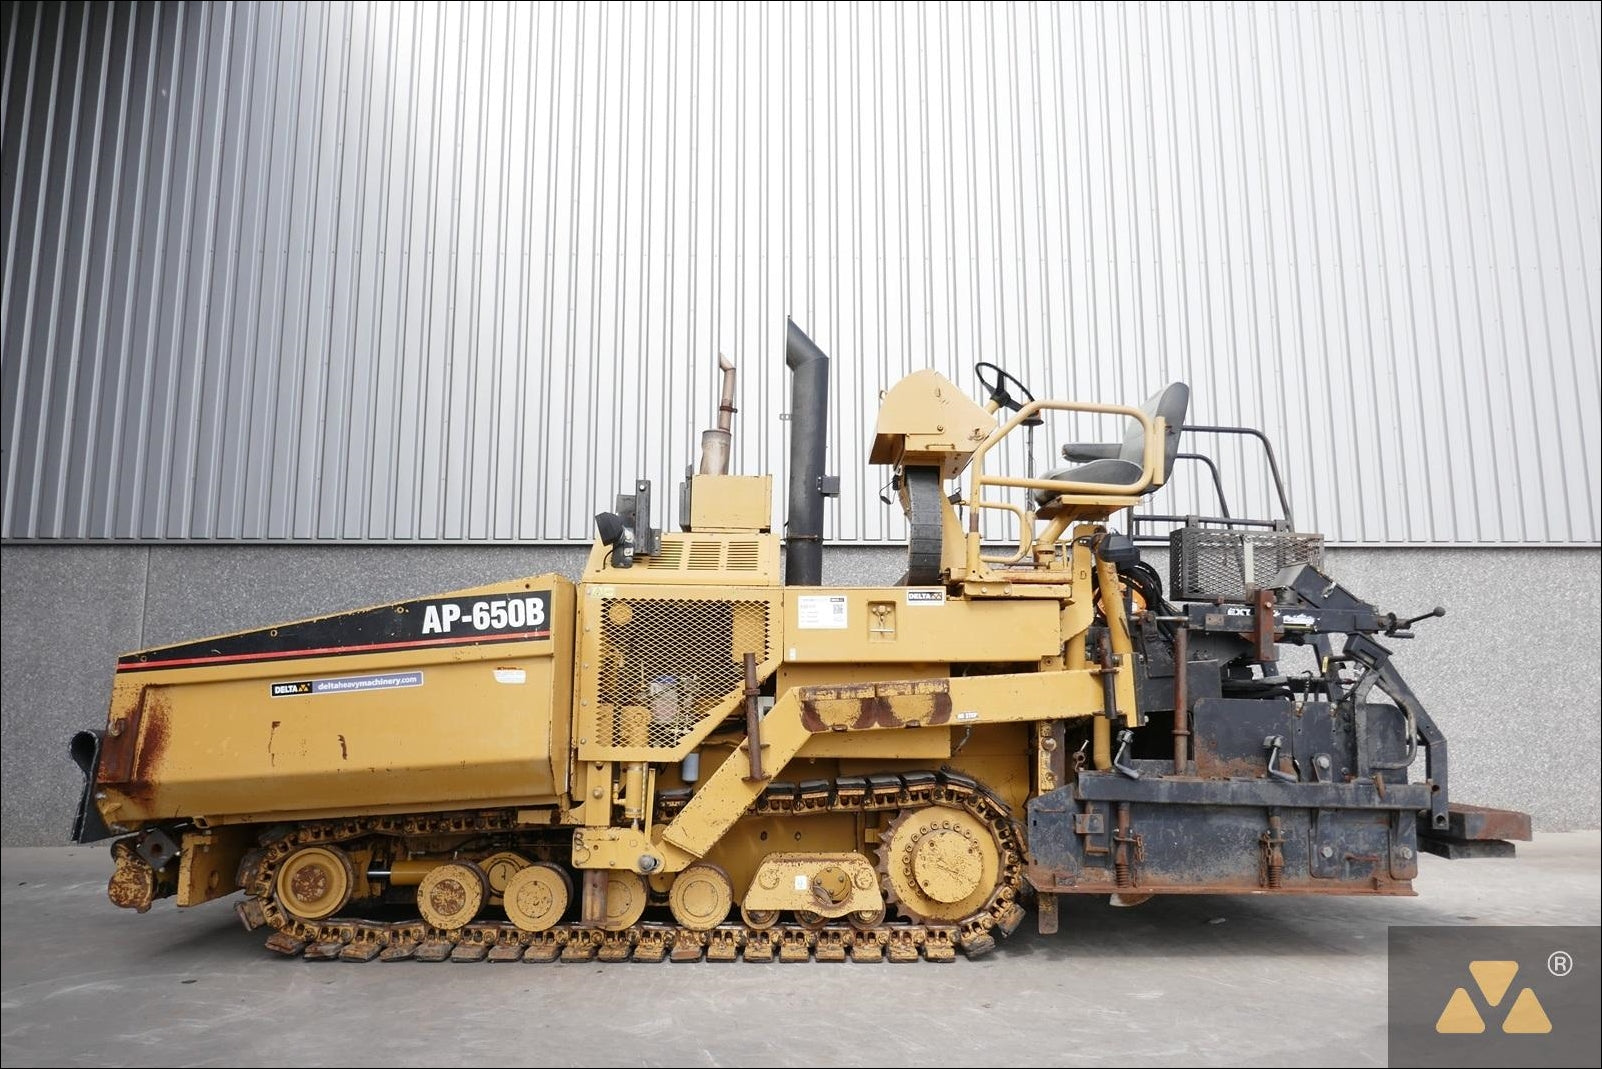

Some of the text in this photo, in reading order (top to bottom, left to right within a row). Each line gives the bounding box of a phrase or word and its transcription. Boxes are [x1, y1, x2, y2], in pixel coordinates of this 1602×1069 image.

[421, 597, 545, 634] AP-650B
[274, 675, 417, 695] DELTA deltaheavymachinery.com
